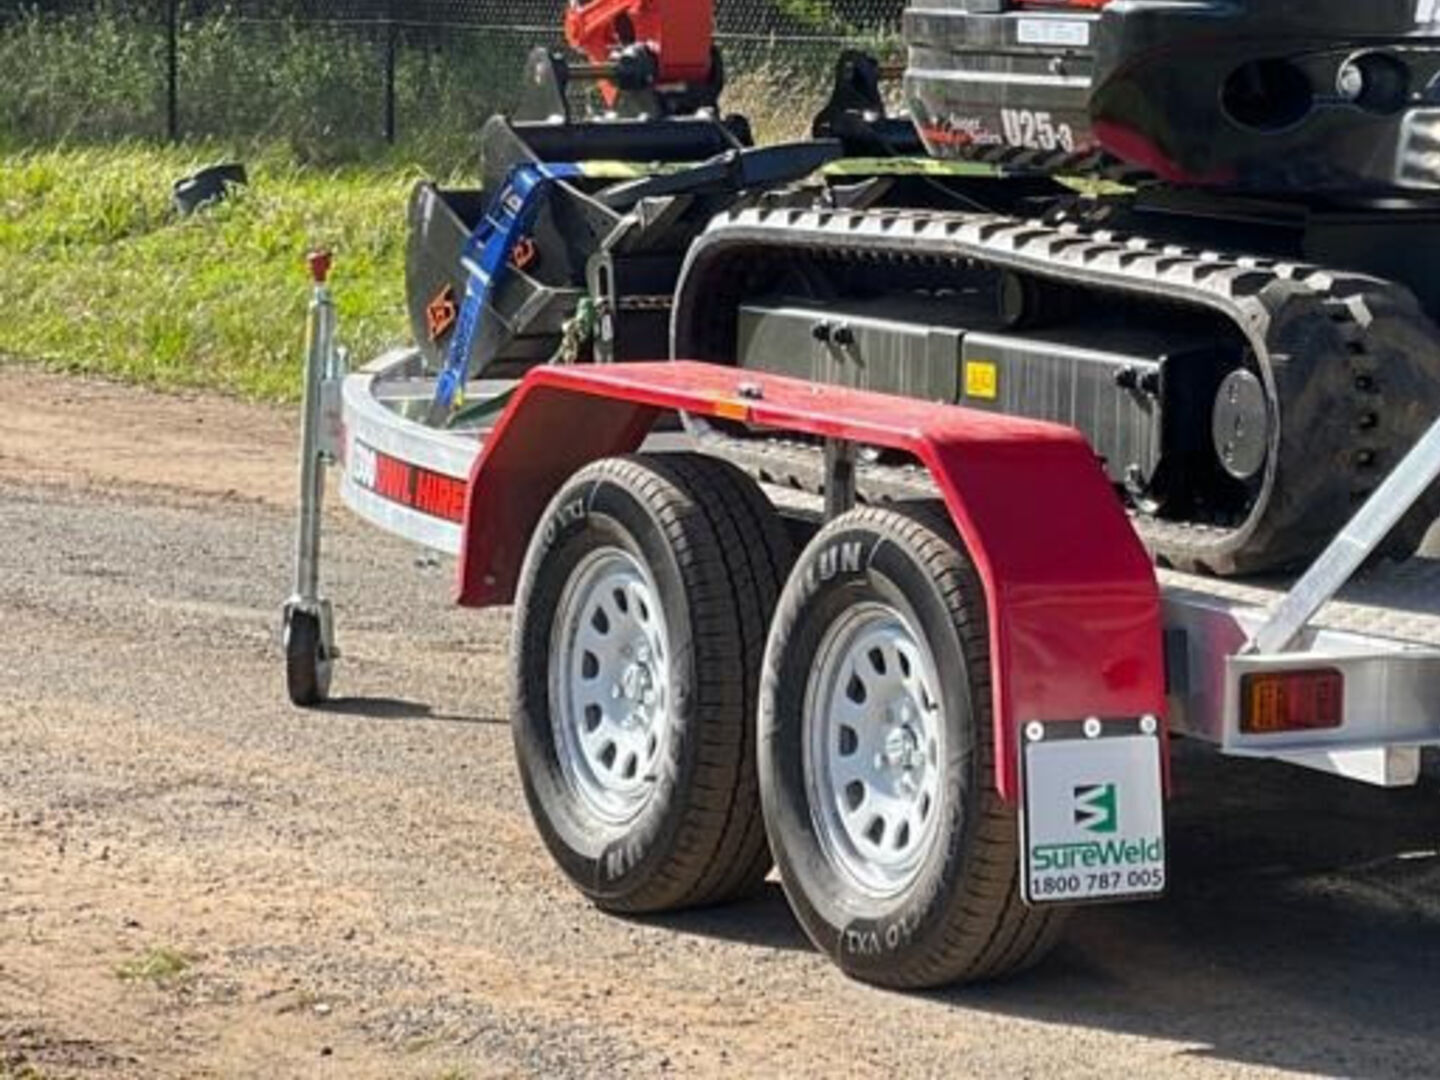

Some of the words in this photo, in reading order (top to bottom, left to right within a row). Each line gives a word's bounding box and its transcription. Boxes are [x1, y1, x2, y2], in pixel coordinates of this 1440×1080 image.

[1001, 109, 1073, 153] U25-3
[1031, 837, 1162, 871] SureWeld
[1032, 876, 1080, 895] 1800
[1085, 872, 1121, 891] 787
[1126, 869, 1163, 887] 005
